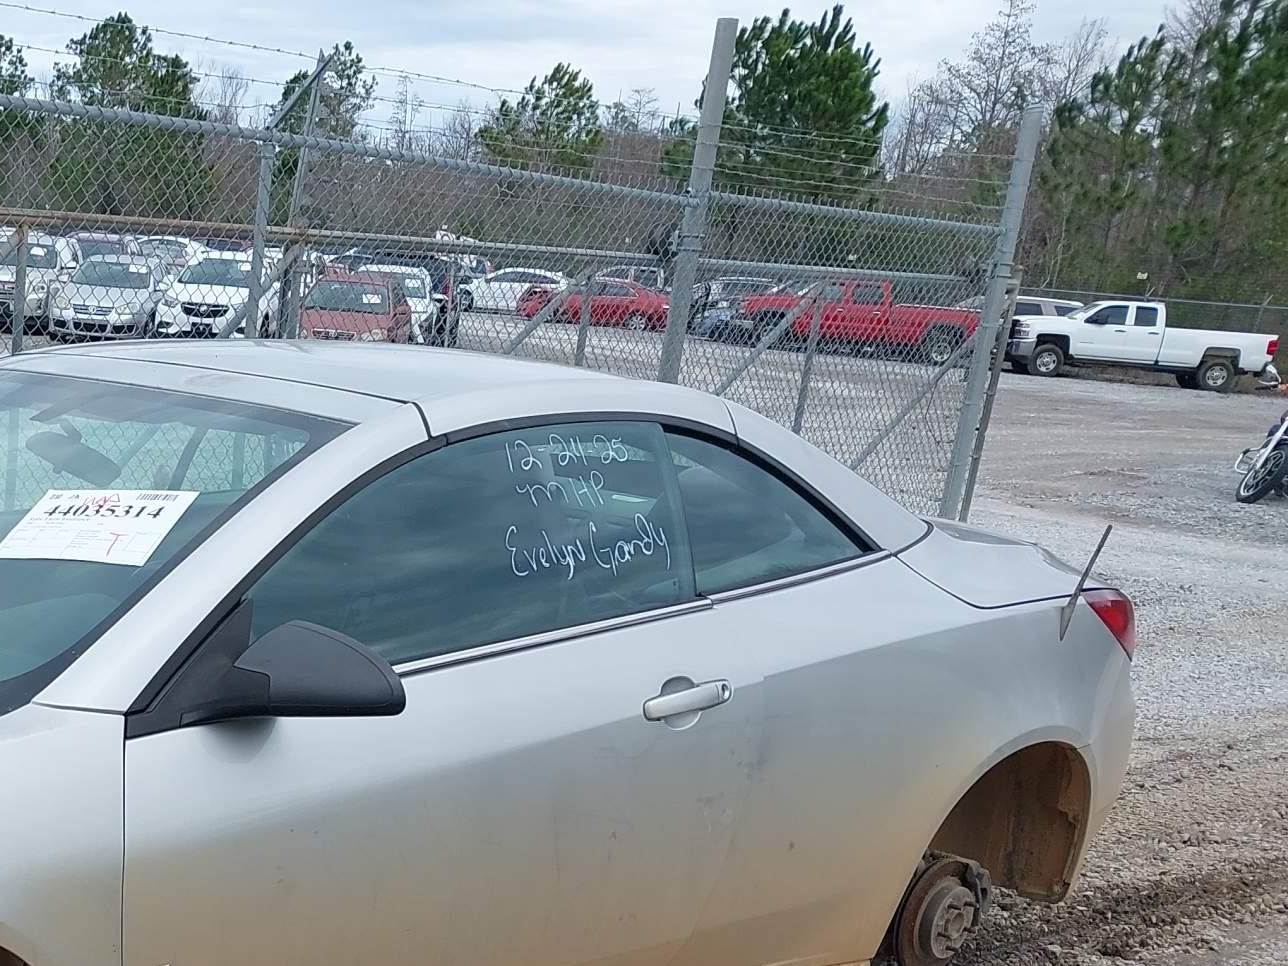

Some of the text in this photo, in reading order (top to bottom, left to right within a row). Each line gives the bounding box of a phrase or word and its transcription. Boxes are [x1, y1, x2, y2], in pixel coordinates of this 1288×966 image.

[505, 433, 629, 473] 12-24-25
[43, 503, 166, 519] 44035314
[505, 525, 587, 580] Evelyn
